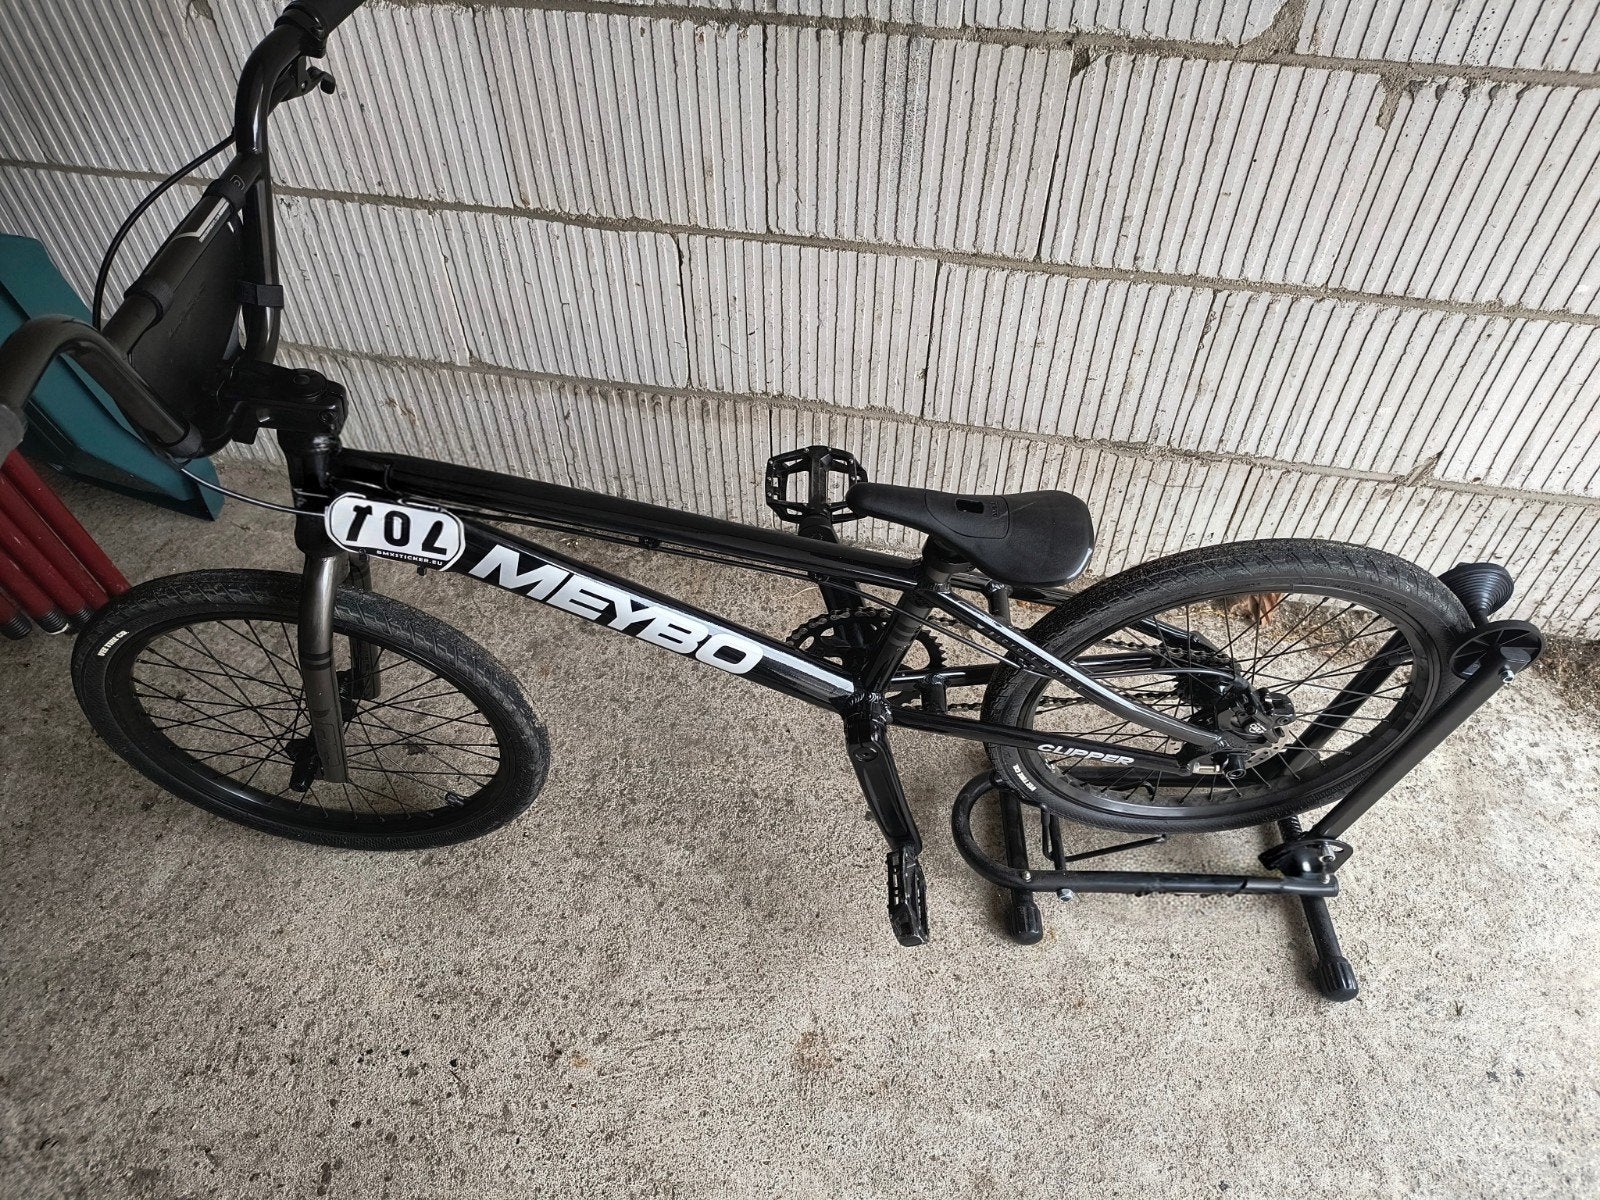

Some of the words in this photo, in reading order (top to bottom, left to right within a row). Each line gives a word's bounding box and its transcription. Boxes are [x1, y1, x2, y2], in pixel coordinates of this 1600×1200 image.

[376, 549, 443, 566] BMXSTICKER.EU
[468, 544, 764, 674] MEYBO
[1037, 744, 1135, 765] CLIPPER
